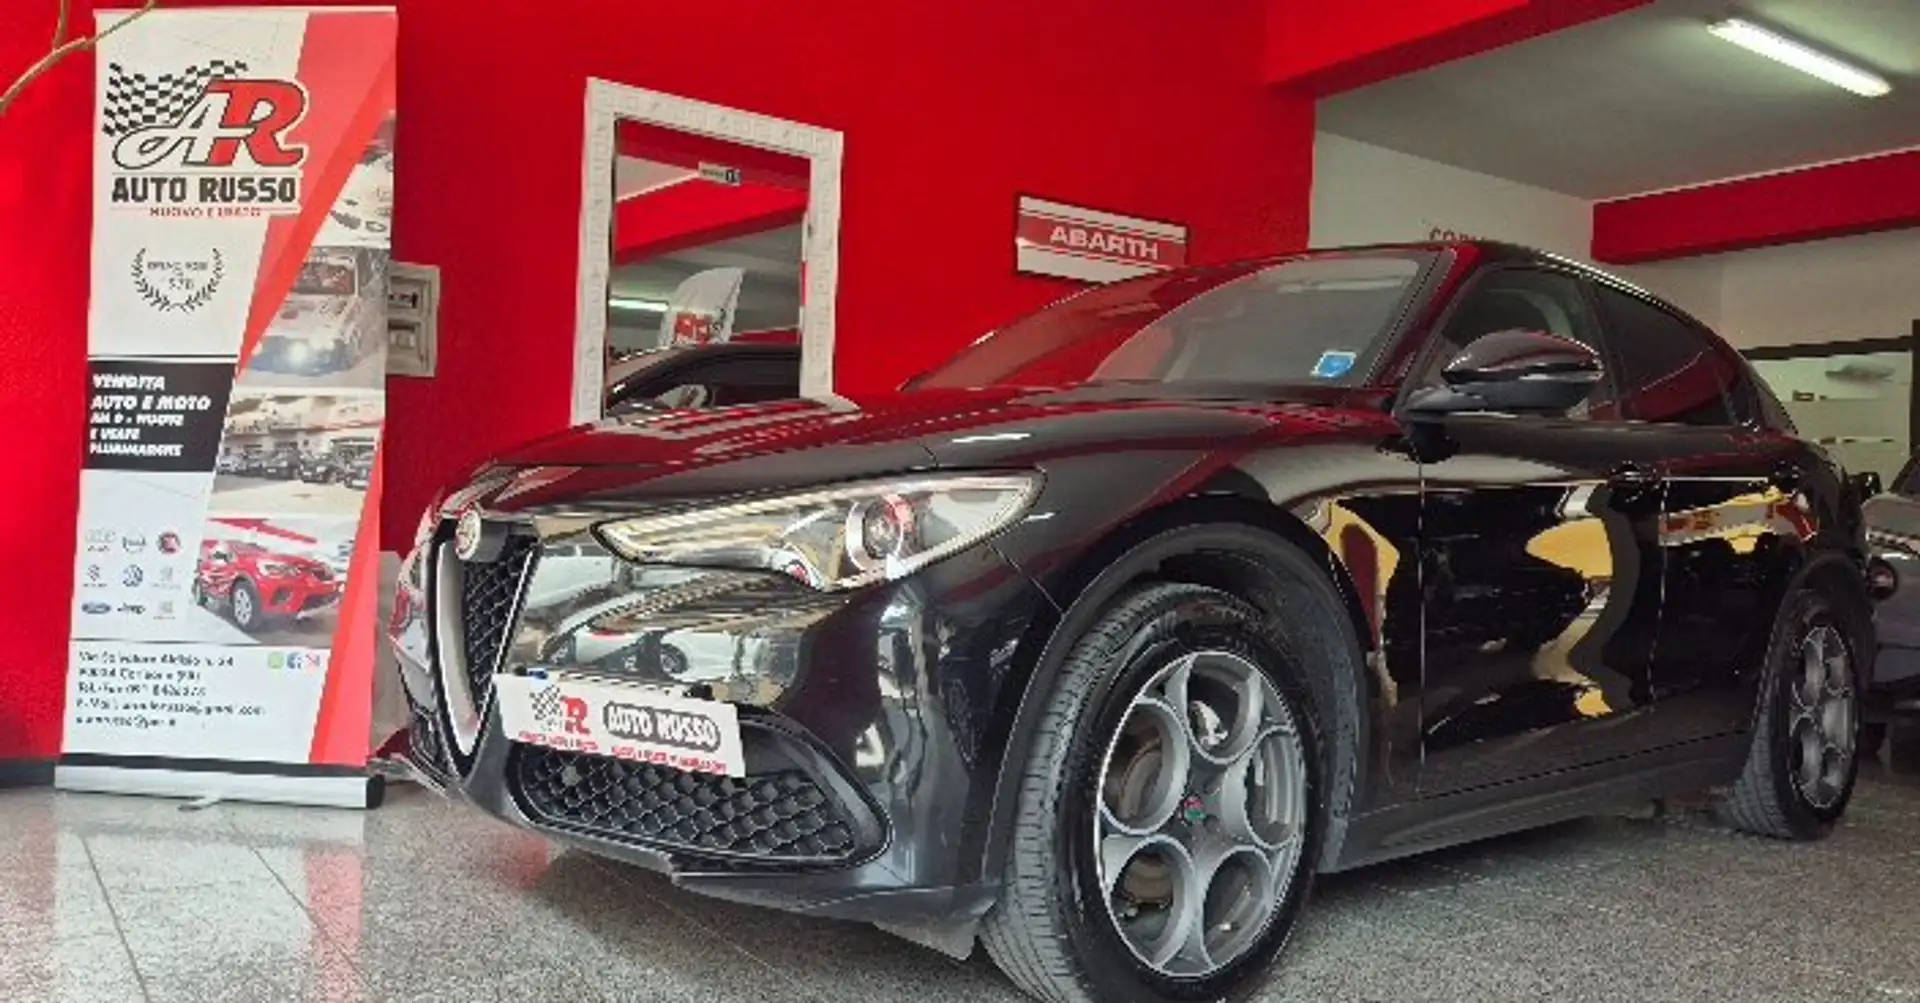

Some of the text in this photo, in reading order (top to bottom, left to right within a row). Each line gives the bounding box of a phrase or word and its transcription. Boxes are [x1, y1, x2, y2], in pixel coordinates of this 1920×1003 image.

[112, 78, 307, 170] AR
[111, 177, 297, 203] AUTO RUSSO
[1050, 225, 1158, 260] ABARTH
[90, 395, 211, 411] AUTO E MOTO
[608, 705, 653, 737] AUTO
[656, 710, 718, 747] RUSSO
